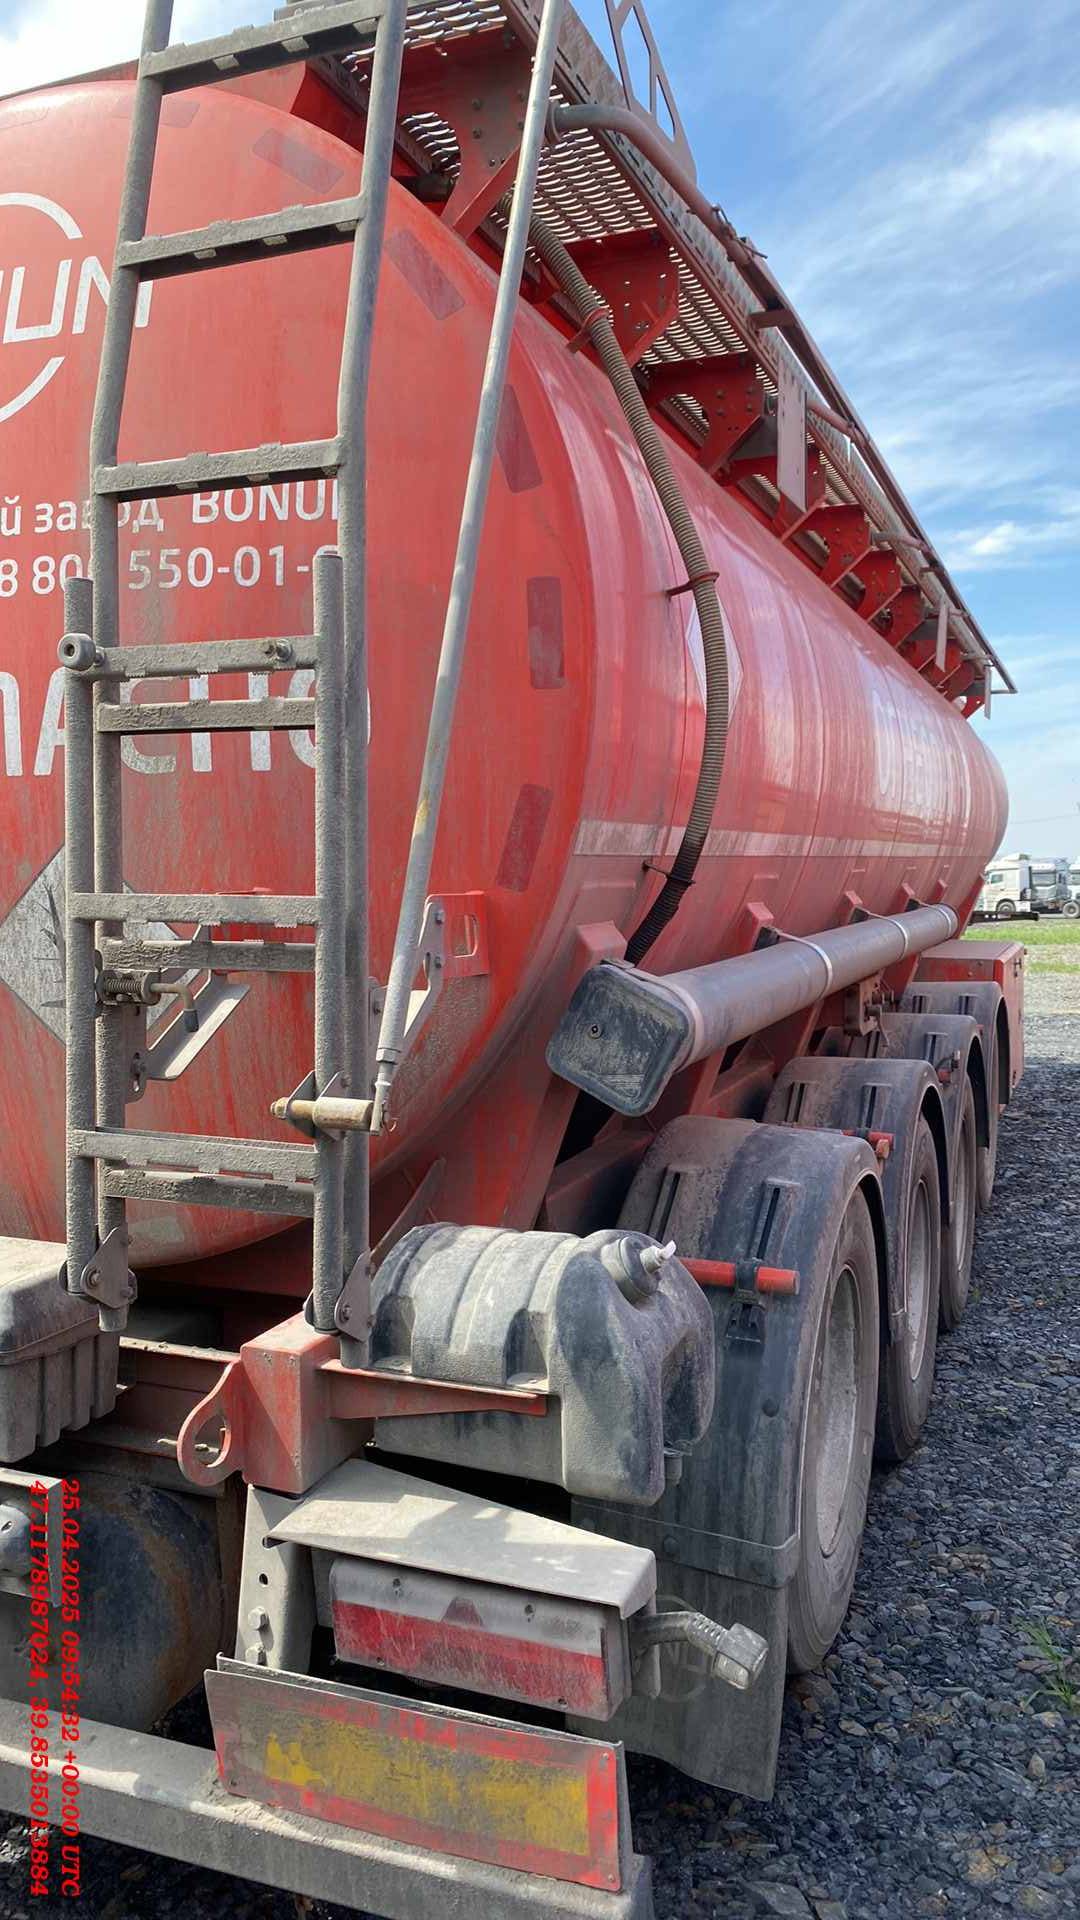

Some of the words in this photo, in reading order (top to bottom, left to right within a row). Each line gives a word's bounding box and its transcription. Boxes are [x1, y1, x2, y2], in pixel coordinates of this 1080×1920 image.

[192, 479, 340, 523] BONU
[0, 559, 18, 597] 8
[32, 553, 93, 594] 80
[129, 544, 341, 589] 550-01-
